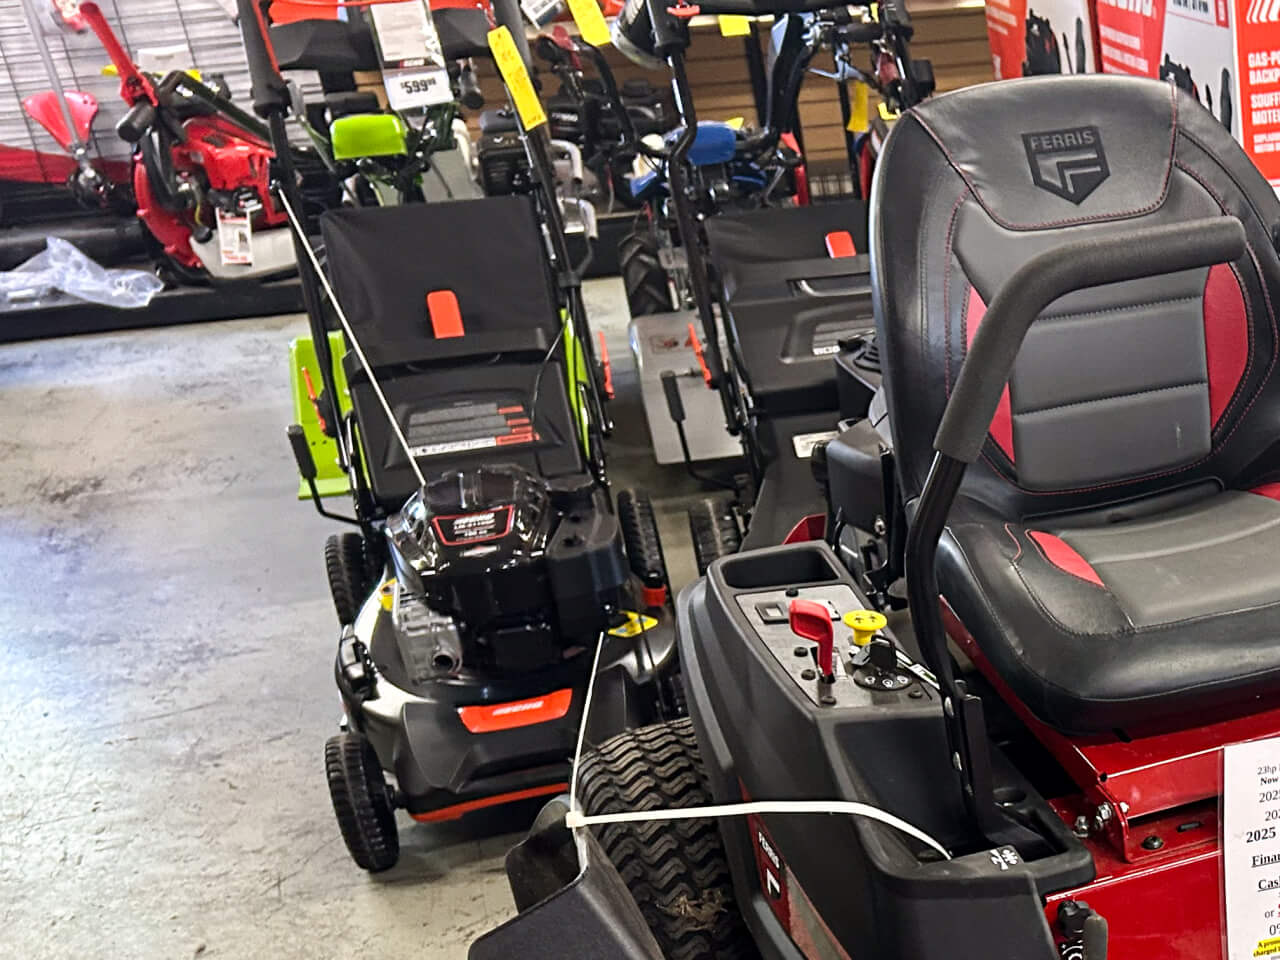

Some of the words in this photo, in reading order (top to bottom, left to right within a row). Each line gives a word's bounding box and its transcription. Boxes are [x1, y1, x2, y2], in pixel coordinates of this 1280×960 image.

[1031, 130, 1094, 150] FERRIS
[1257, 766, 1277, 775] 23hp
[1260, 776, 1278, 786] Now
[1246, 827, 1276, 843] 2025
[1265, 910, 1274, 918] or
